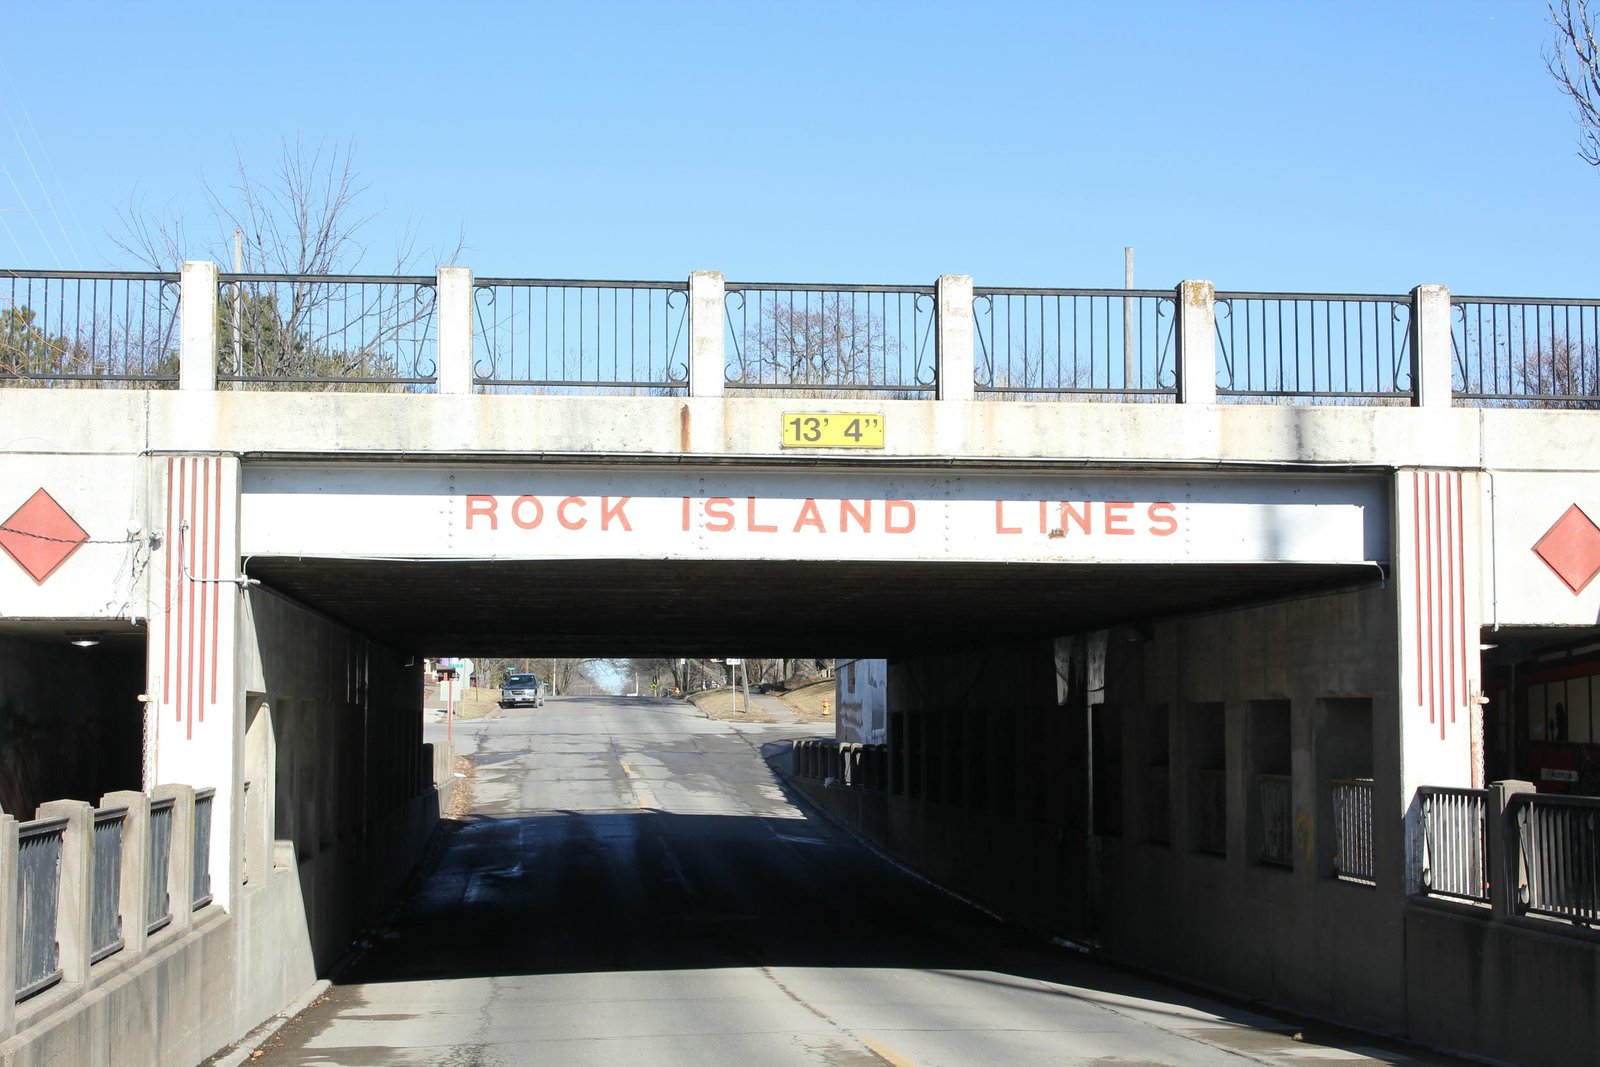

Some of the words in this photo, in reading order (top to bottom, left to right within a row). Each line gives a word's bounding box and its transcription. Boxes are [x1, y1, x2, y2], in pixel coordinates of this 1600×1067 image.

[789, 417, 829, 442] 13'
[466, 494, 633, 532] ROCK
[682, 496, 916, 534] ISLAND
[995, 500, 1178, 537] LINES
